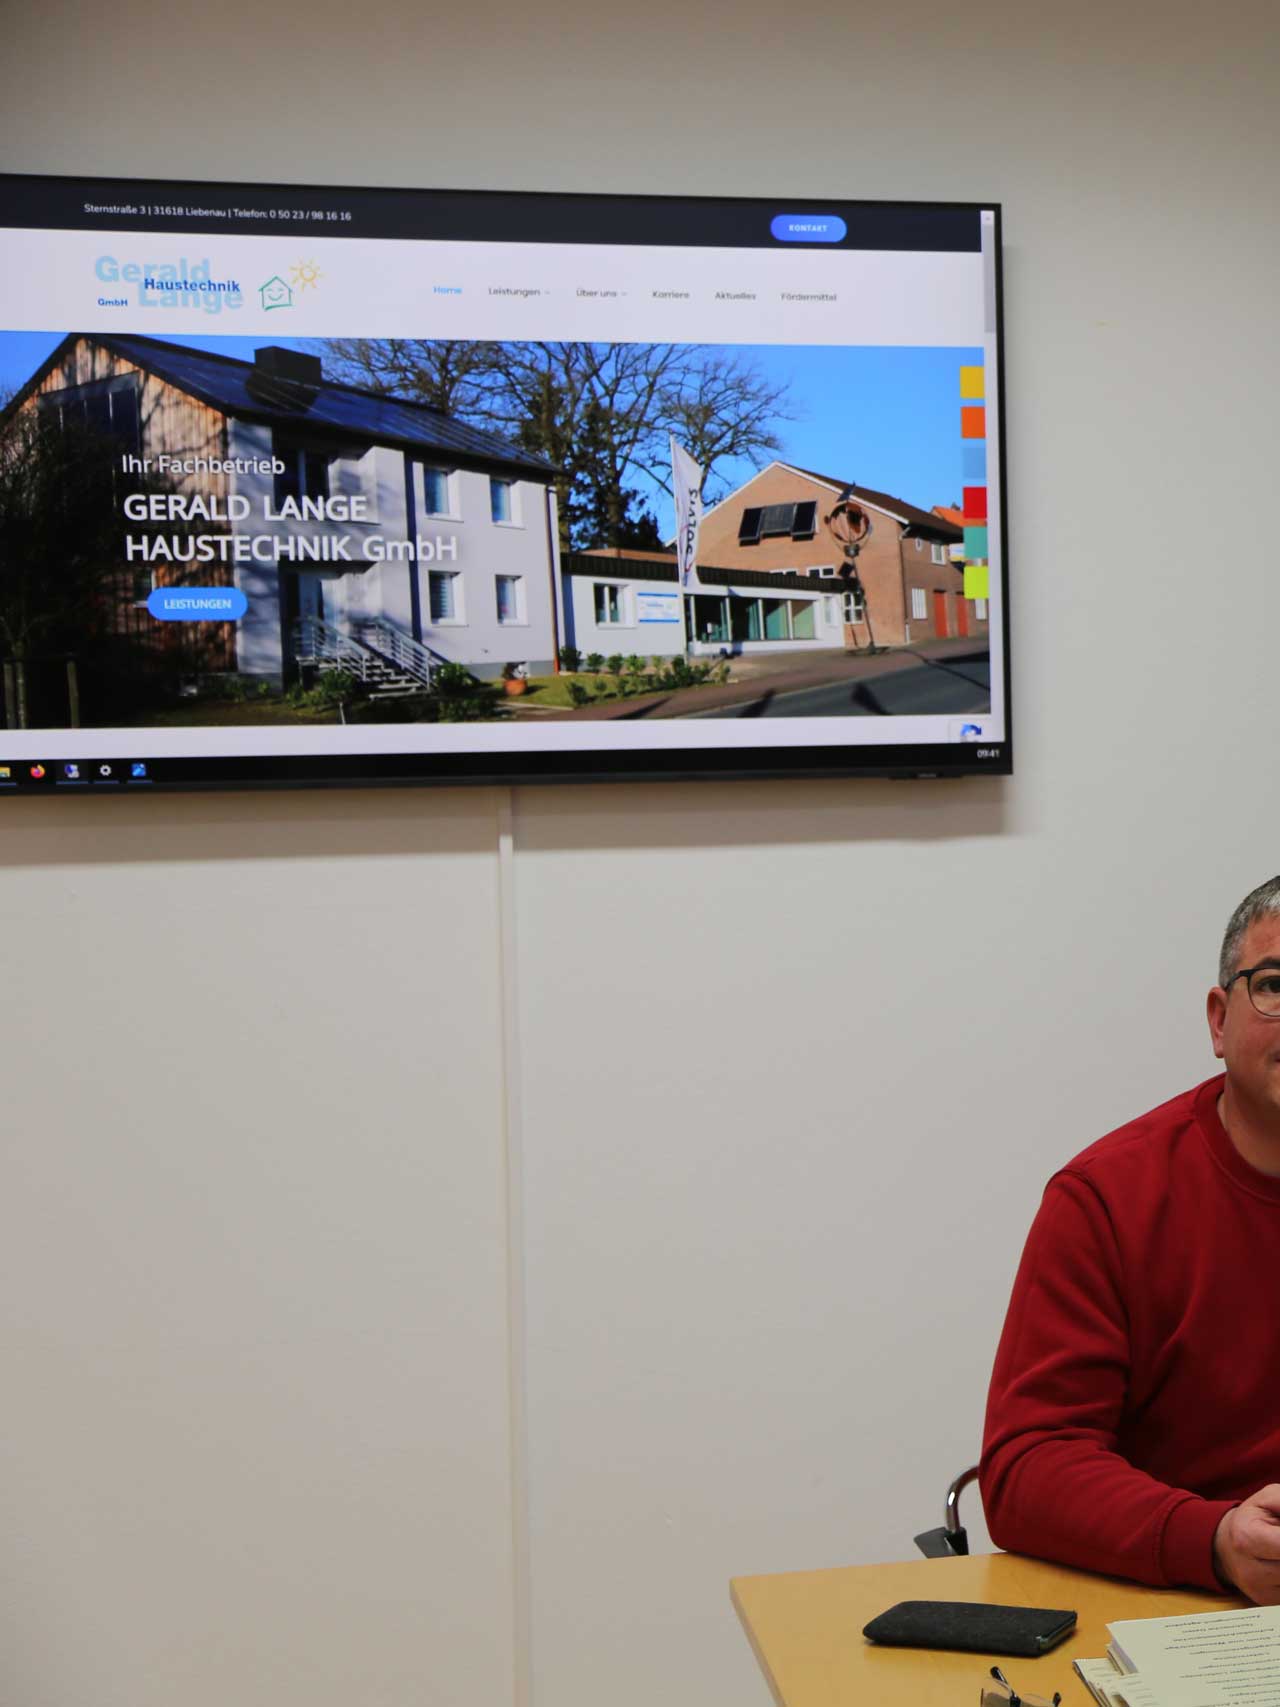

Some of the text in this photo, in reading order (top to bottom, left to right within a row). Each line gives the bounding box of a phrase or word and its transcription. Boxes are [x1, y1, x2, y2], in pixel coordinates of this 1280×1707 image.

[84, 203, 138, 214] Sternstraße
[139, 205, 146, 214] 3
[153, 205, 184, 216] 31618
[185, 207, 226, 217] Liebenau
[233, 208, 268, 218] Telefon:
[269, 209, 277, 219] 0
[292, 210, 304, 220] 23
[788, 224, 828, 232] KONTAKT
[95, 255, 211, 283] Gerald
[144, 278, 241, 293] Haustechnik
[433, 286, 463, 294] Home
[488, 287, 541, 298] Leistungen
[97, 298, 128, 307] GmbH
[138, 281, 244, 315] Lange
[121, 455, 286, 475] Ihr Fachbetrieb
[124, 495, 368, 522] GERALD LANGE
[126, 535, 457, 562] HAUSTECHNIK GmbH
[164, 598, 232, 610] LEISTUNGEN
